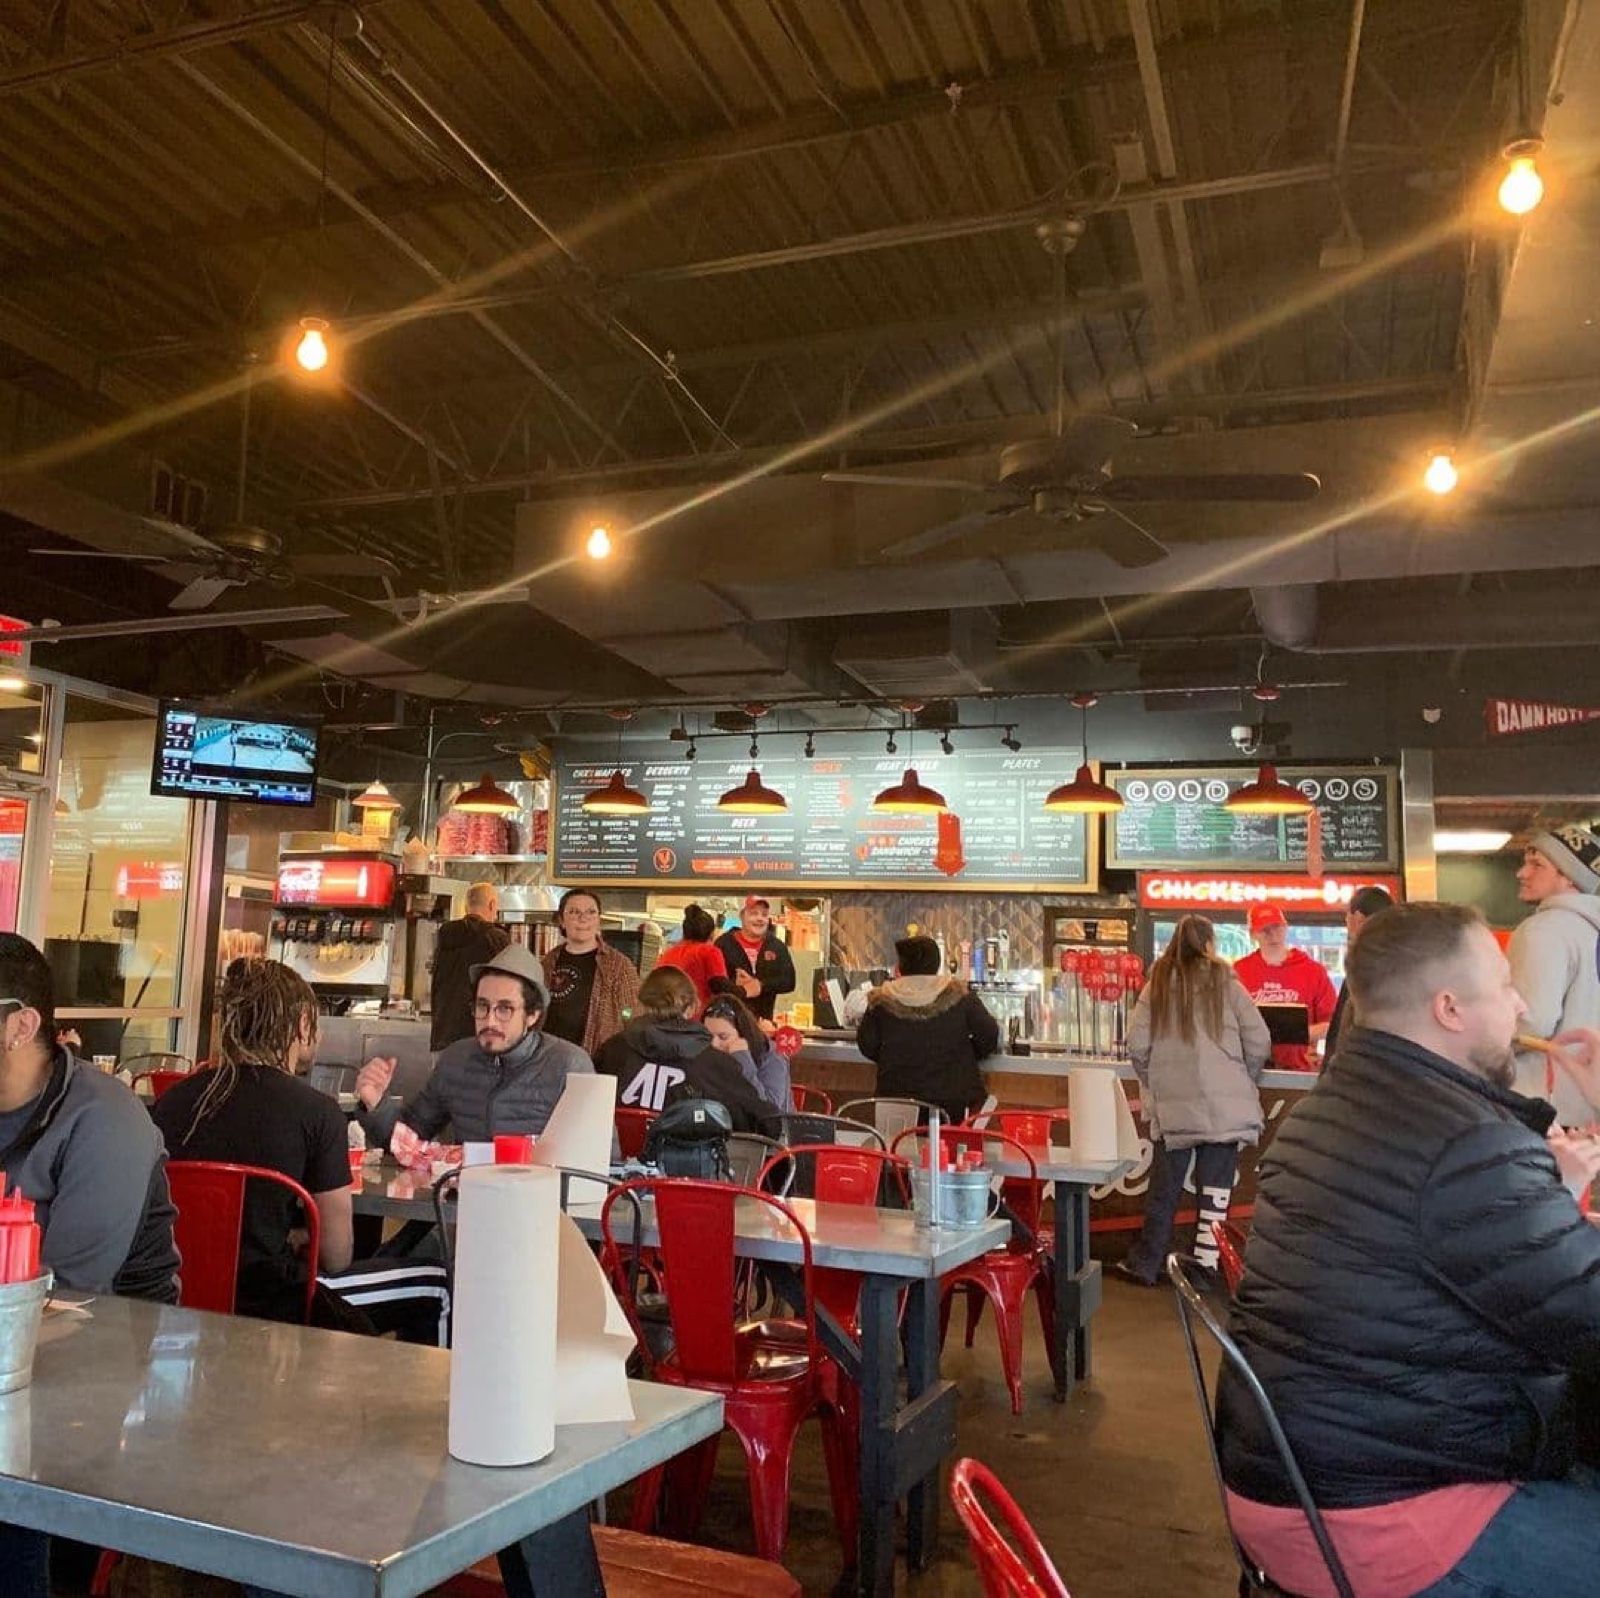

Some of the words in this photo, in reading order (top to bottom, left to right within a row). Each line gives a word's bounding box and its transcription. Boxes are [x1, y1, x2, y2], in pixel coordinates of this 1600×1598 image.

[1496, 701, 1545, 732] DAMN
[875, 760, 902, 771] HEAT
[1002, 758, 1042, 770] PLATES
[1126, 779, 1229, 802] COLD
[731, 818, 758, 829] BEER
[1147, 879, 1267, 903] CHICKEN
[779, 1035, 797, 1047] 24
